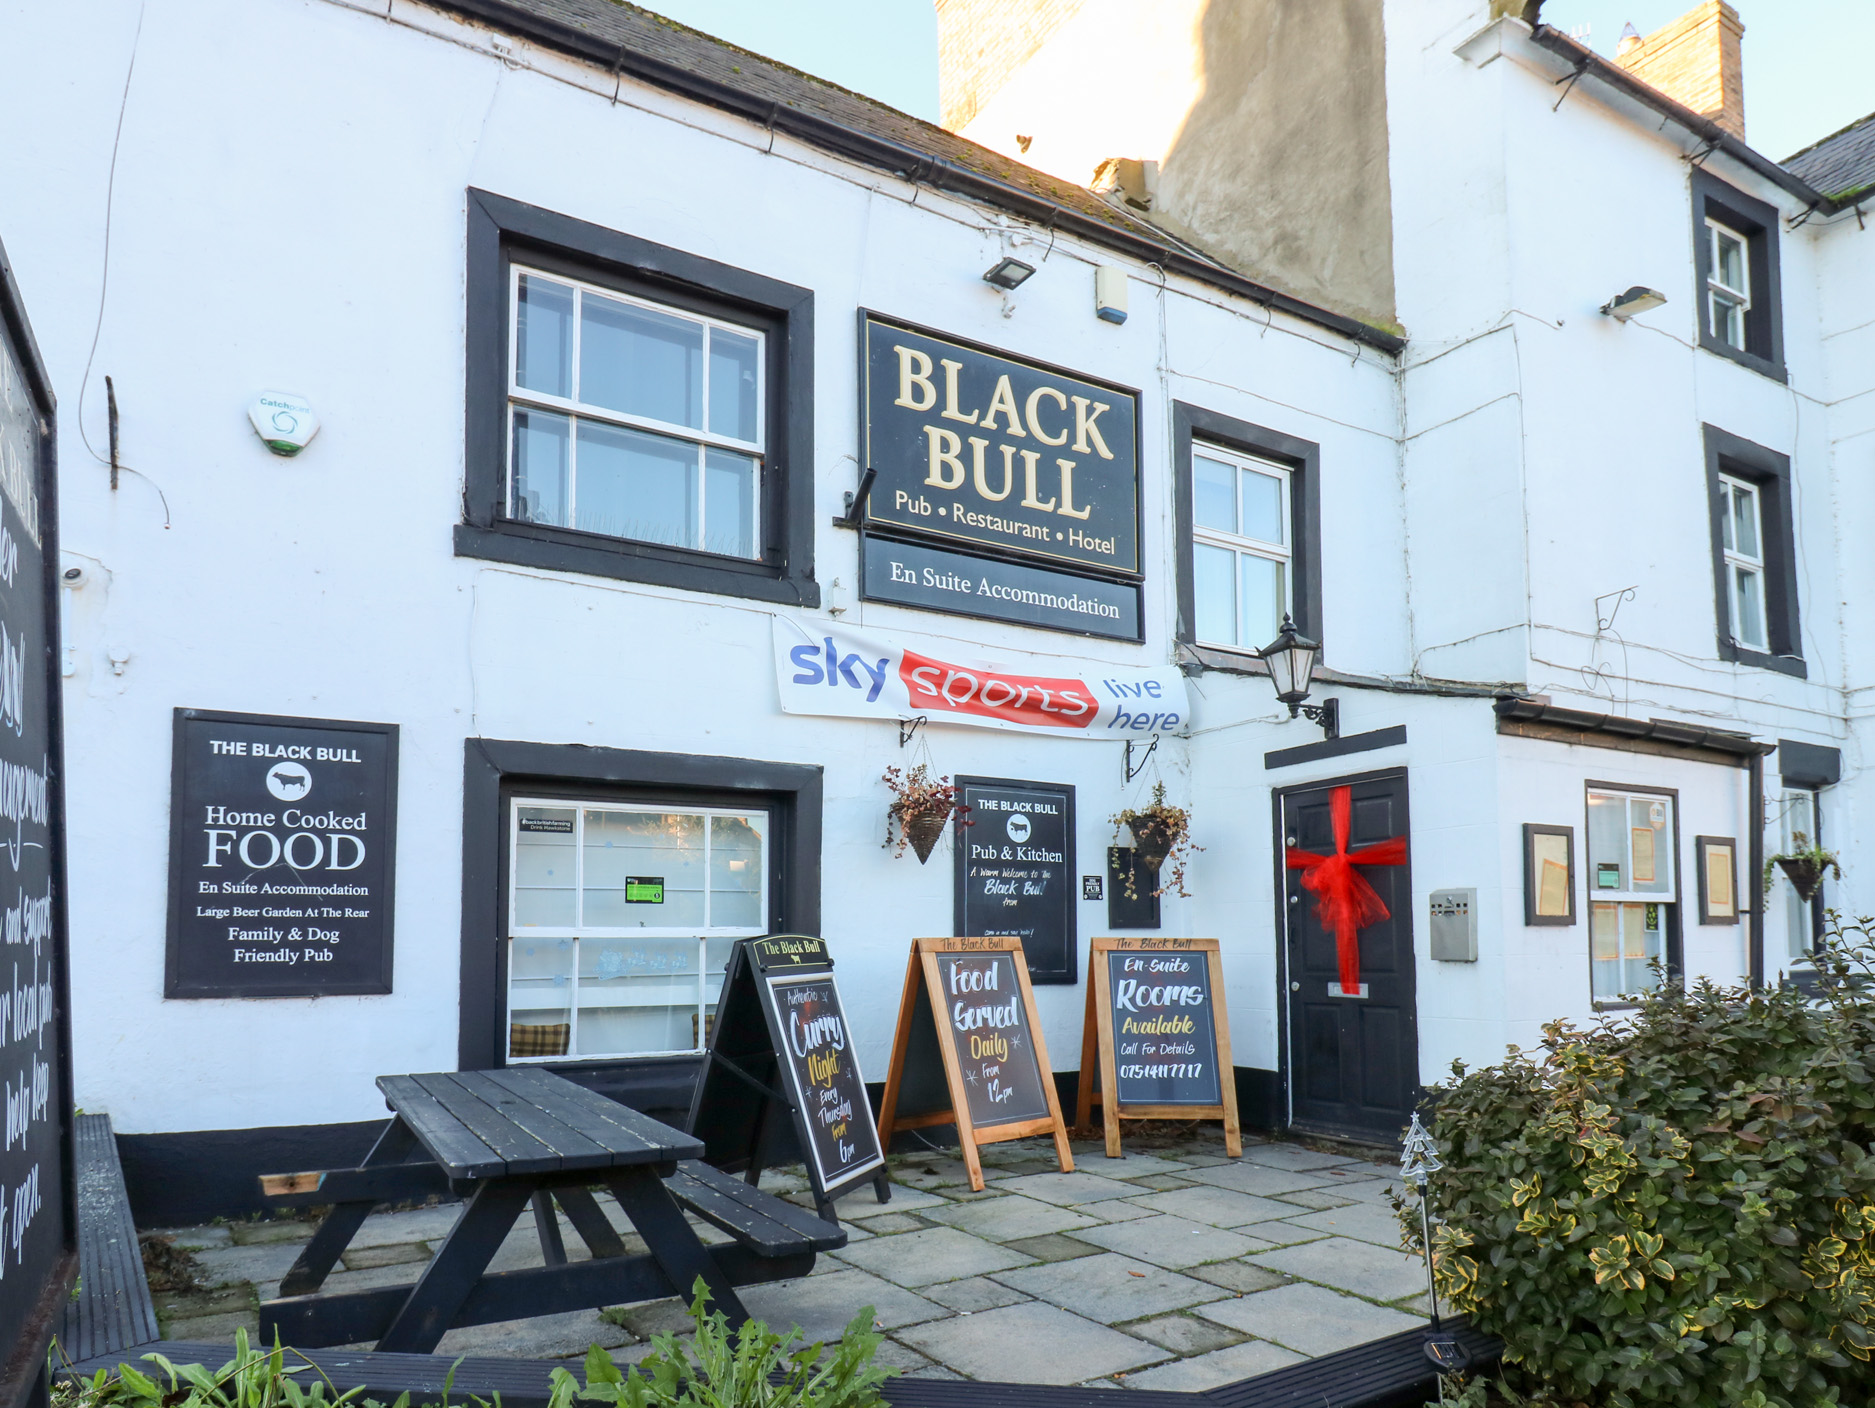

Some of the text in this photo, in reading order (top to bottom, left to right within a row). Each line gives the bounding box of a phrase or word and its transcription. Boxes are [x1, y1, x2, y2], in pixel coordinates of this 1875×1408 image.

[893, 344, 1114, 460] BLACK
[923, 424, 1091, 521] BULL
[9, 439, 41, 551] BULL
[895, 490, 1115, 555] Pub Restaurant Hotel
[890, 561, 1120, 619] En Suite Accommodation
[789, 636, 1089, 717] sky sports
[1103, 678, 1162, 699] live
[1108, 704, 1180, 732] here
[210, 740, 361, 763] THE BLACK BULL
[205, 806, 367, 831] Home Cooked
[978, 799, 1059, 815] THE BLACK BULL
[202, 829, 366, 871] FOOD
[971, 845, 1063, 863] Pub & Kitchen
[970, 866, 977, 877] A
[1002, 868, 1028, 878] Welcome
[1031, 870, 1038, 878] to
[198, 881, 369, 896] En Suite Accommodation
[984, 879, 1019, 895] Black
[6, 886, 22, 945] and
[24, 875, 52, 956] support
[197, 906, 369, 920] Large Beer Garden At The Rear
[228, 927, 340, 943] Family & Dog
[940, 938, 1004, 950] The Black Bull
[1114, 938, 1192, 950] The Black Bull
[233, 949, 333, 965] Friendly Pub
[762, 940, 821, 955] The Black Bull
[950, 960, 998, 995] Food
[14, 953, 37, 1042] local
[39, 961, 53, 1050] pub
[1116, 978, 1204, 1013] Rooms
[954, 996, 1019, 1031] Served
[1122, 1015, 1196, 1036] Available
[790, 1009, 846, 1058] Curry
[970, 1032, 1008, 1063] Daily
[1121, 1041, 1195, 1056] Call For Details
[808, 1049, 841, 1088] Night
[982, 1062, 1000, 1079] From
[1120, 1063, 1203, 1080] 07514117717
[6, 1052, 49, 1151] help keep
[820, 1087, 838, 1105] Every
[987, 1079, 1013, 1104] 12pm
[818, 1099, 852, 1128] Thursday
[832, 1122, 847, 1142] From
[839, 1139, 855, 1163] 6pm
